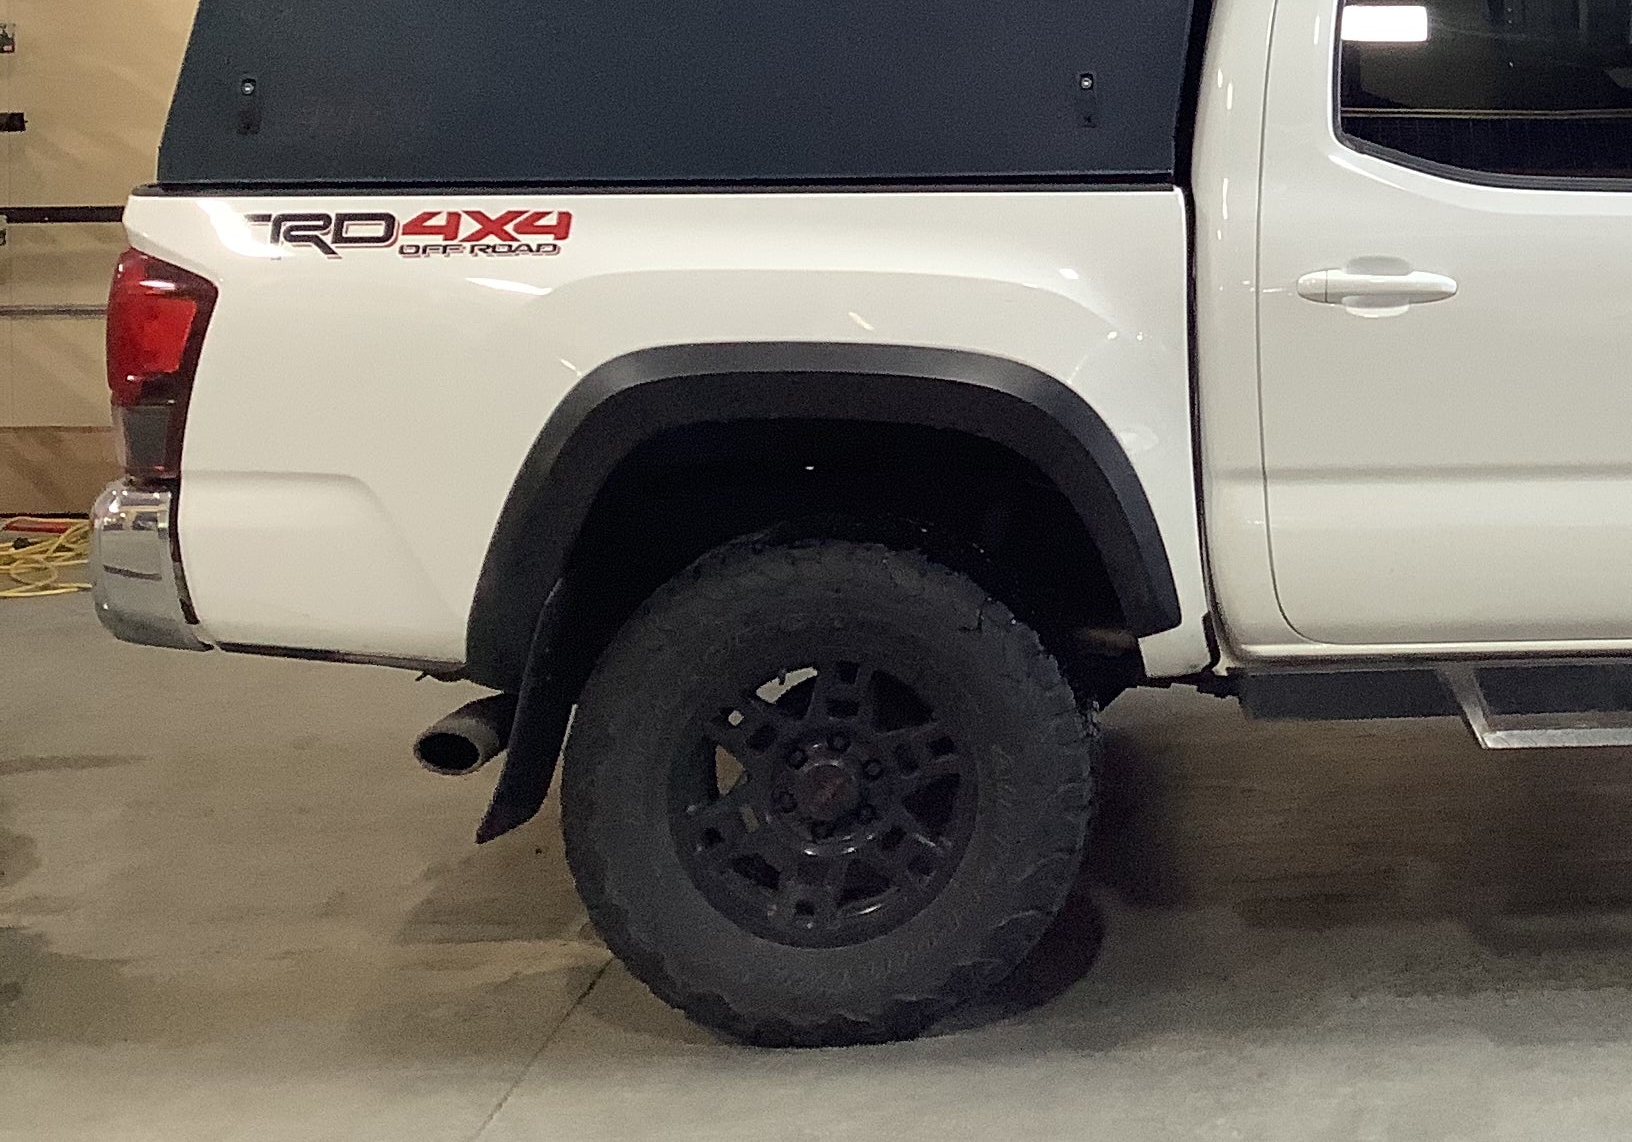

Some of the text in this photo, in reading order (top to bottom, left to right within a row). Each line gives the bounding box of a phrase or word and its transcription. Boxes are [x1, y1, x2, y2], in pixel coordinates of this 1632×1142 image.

[402, 210, 573, 242] 4X4
[399, 243, 560, 257] OFF ROAD
